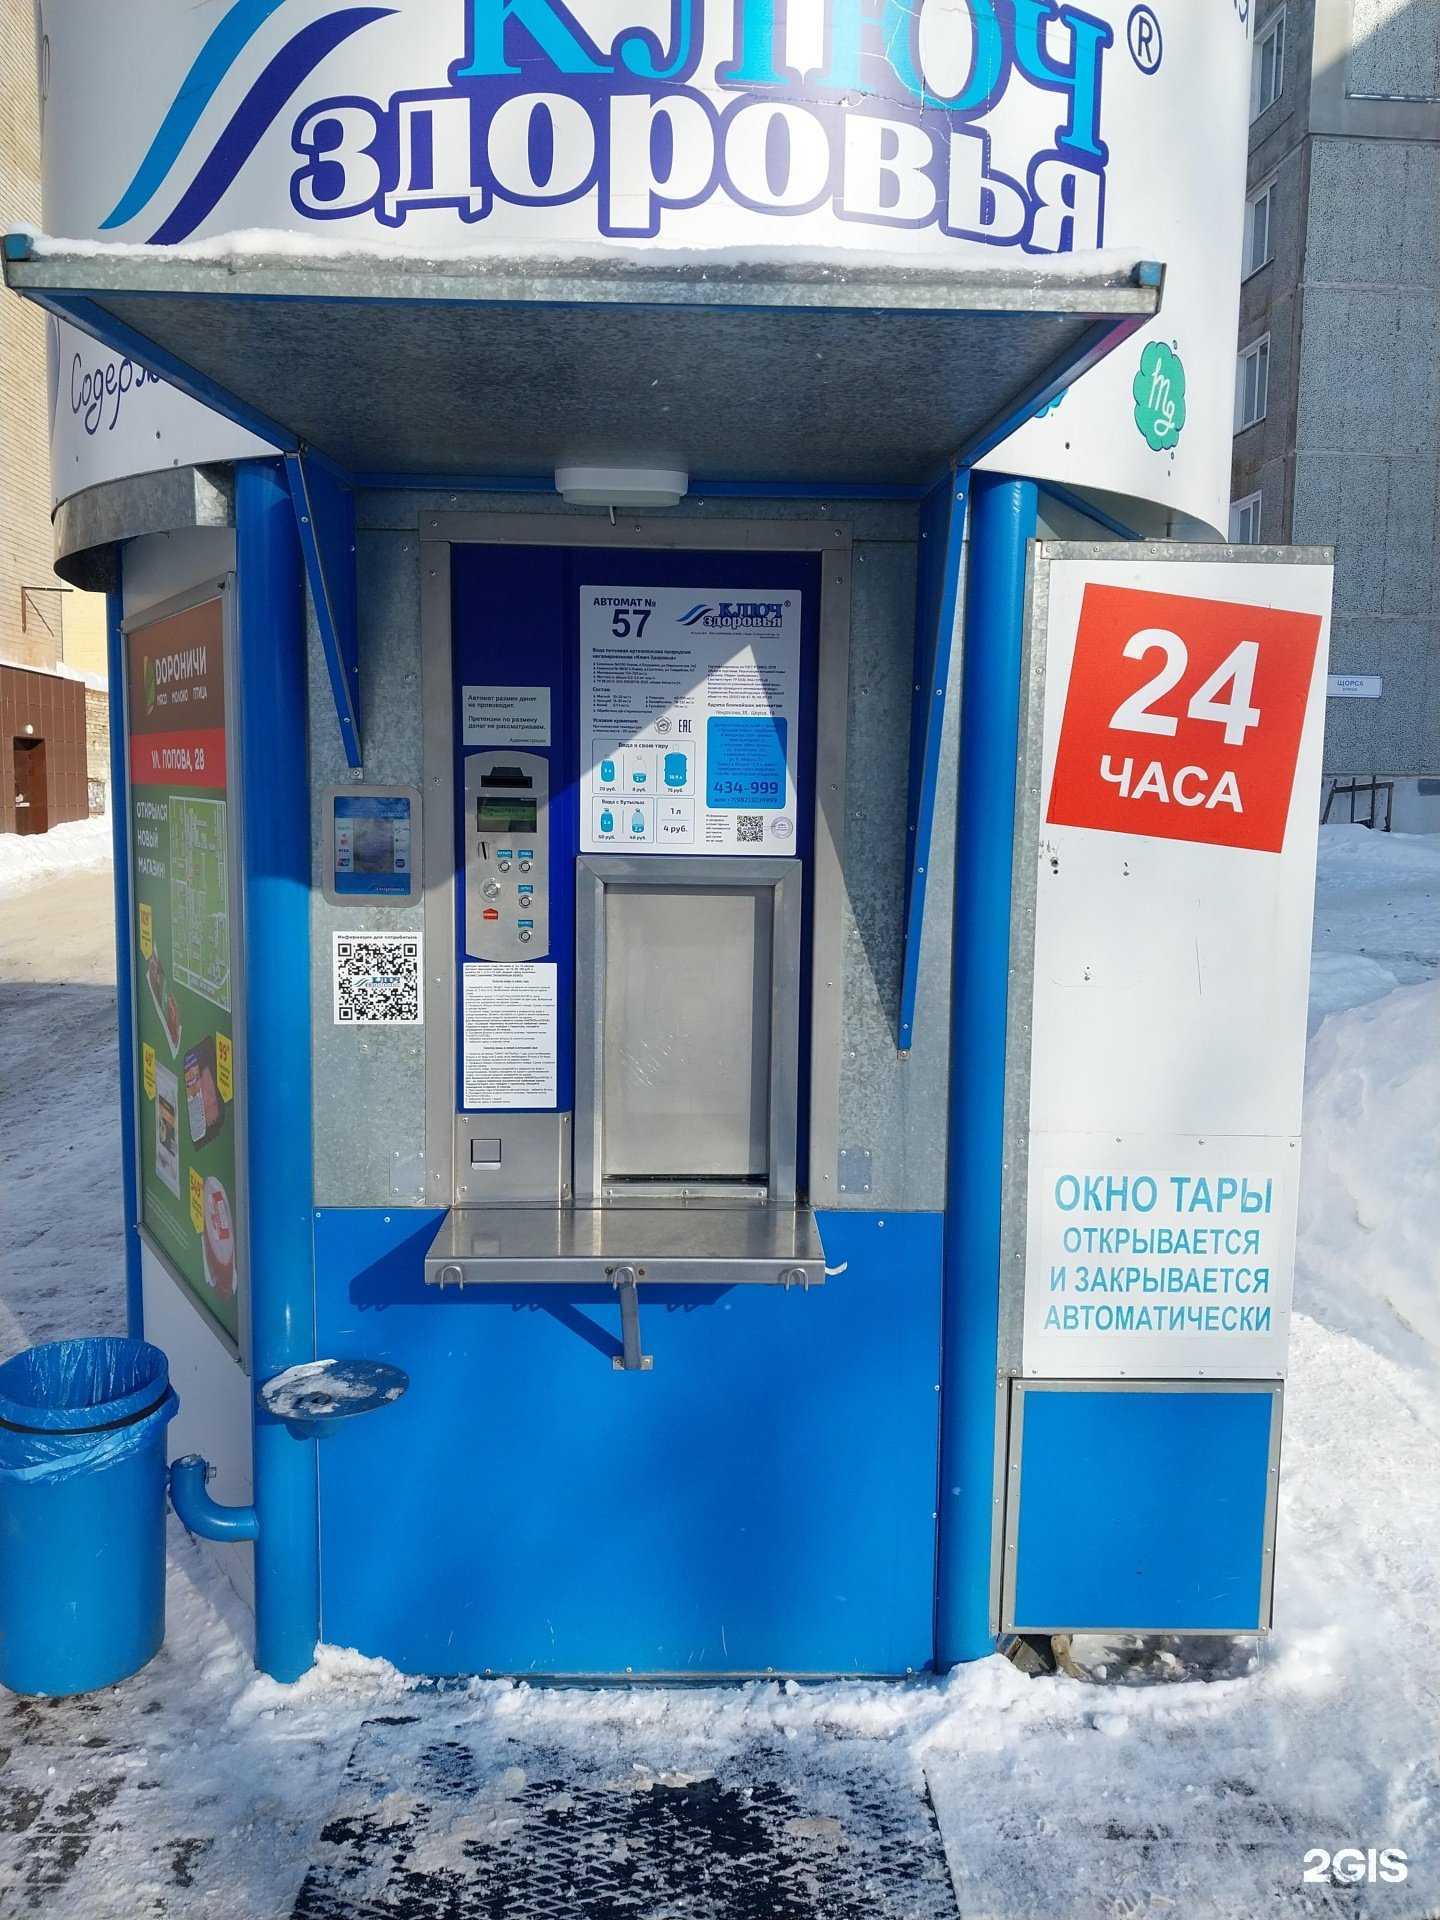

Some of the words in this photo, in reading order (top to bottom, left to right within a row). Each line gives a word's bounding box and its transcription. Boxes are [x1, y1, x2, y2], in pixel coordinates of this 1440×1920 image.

[593, 598, 642, 607] АВТОМАТ
[612, 609, 651, 638] 57
[155, 646, 207, 686] ДОРОНИЧИ
[1108, 628, 1261, 746] 24
[194, 748, 205, 770] 28
[713, 781, 779, 795] 434-999
[1100, 754, 1244, 814] ЧАСА
[670, 825, 687, 834] руб.
[1054, 1174, 1158, 1213] ОКНО
[1170, 1176, 1273, 1214] ТАРЫ
[1063, 1227, 1260, 1256] ОТКРЫВАЕТСЯ
[1050, 1266, 1067, 1292] И
[1074, 1266, 1270, 1294] ЗАКРЫВАЕТСЯ
[1044, 1304, 1271, 1331] АВТОМАТИЧЕСКИ
